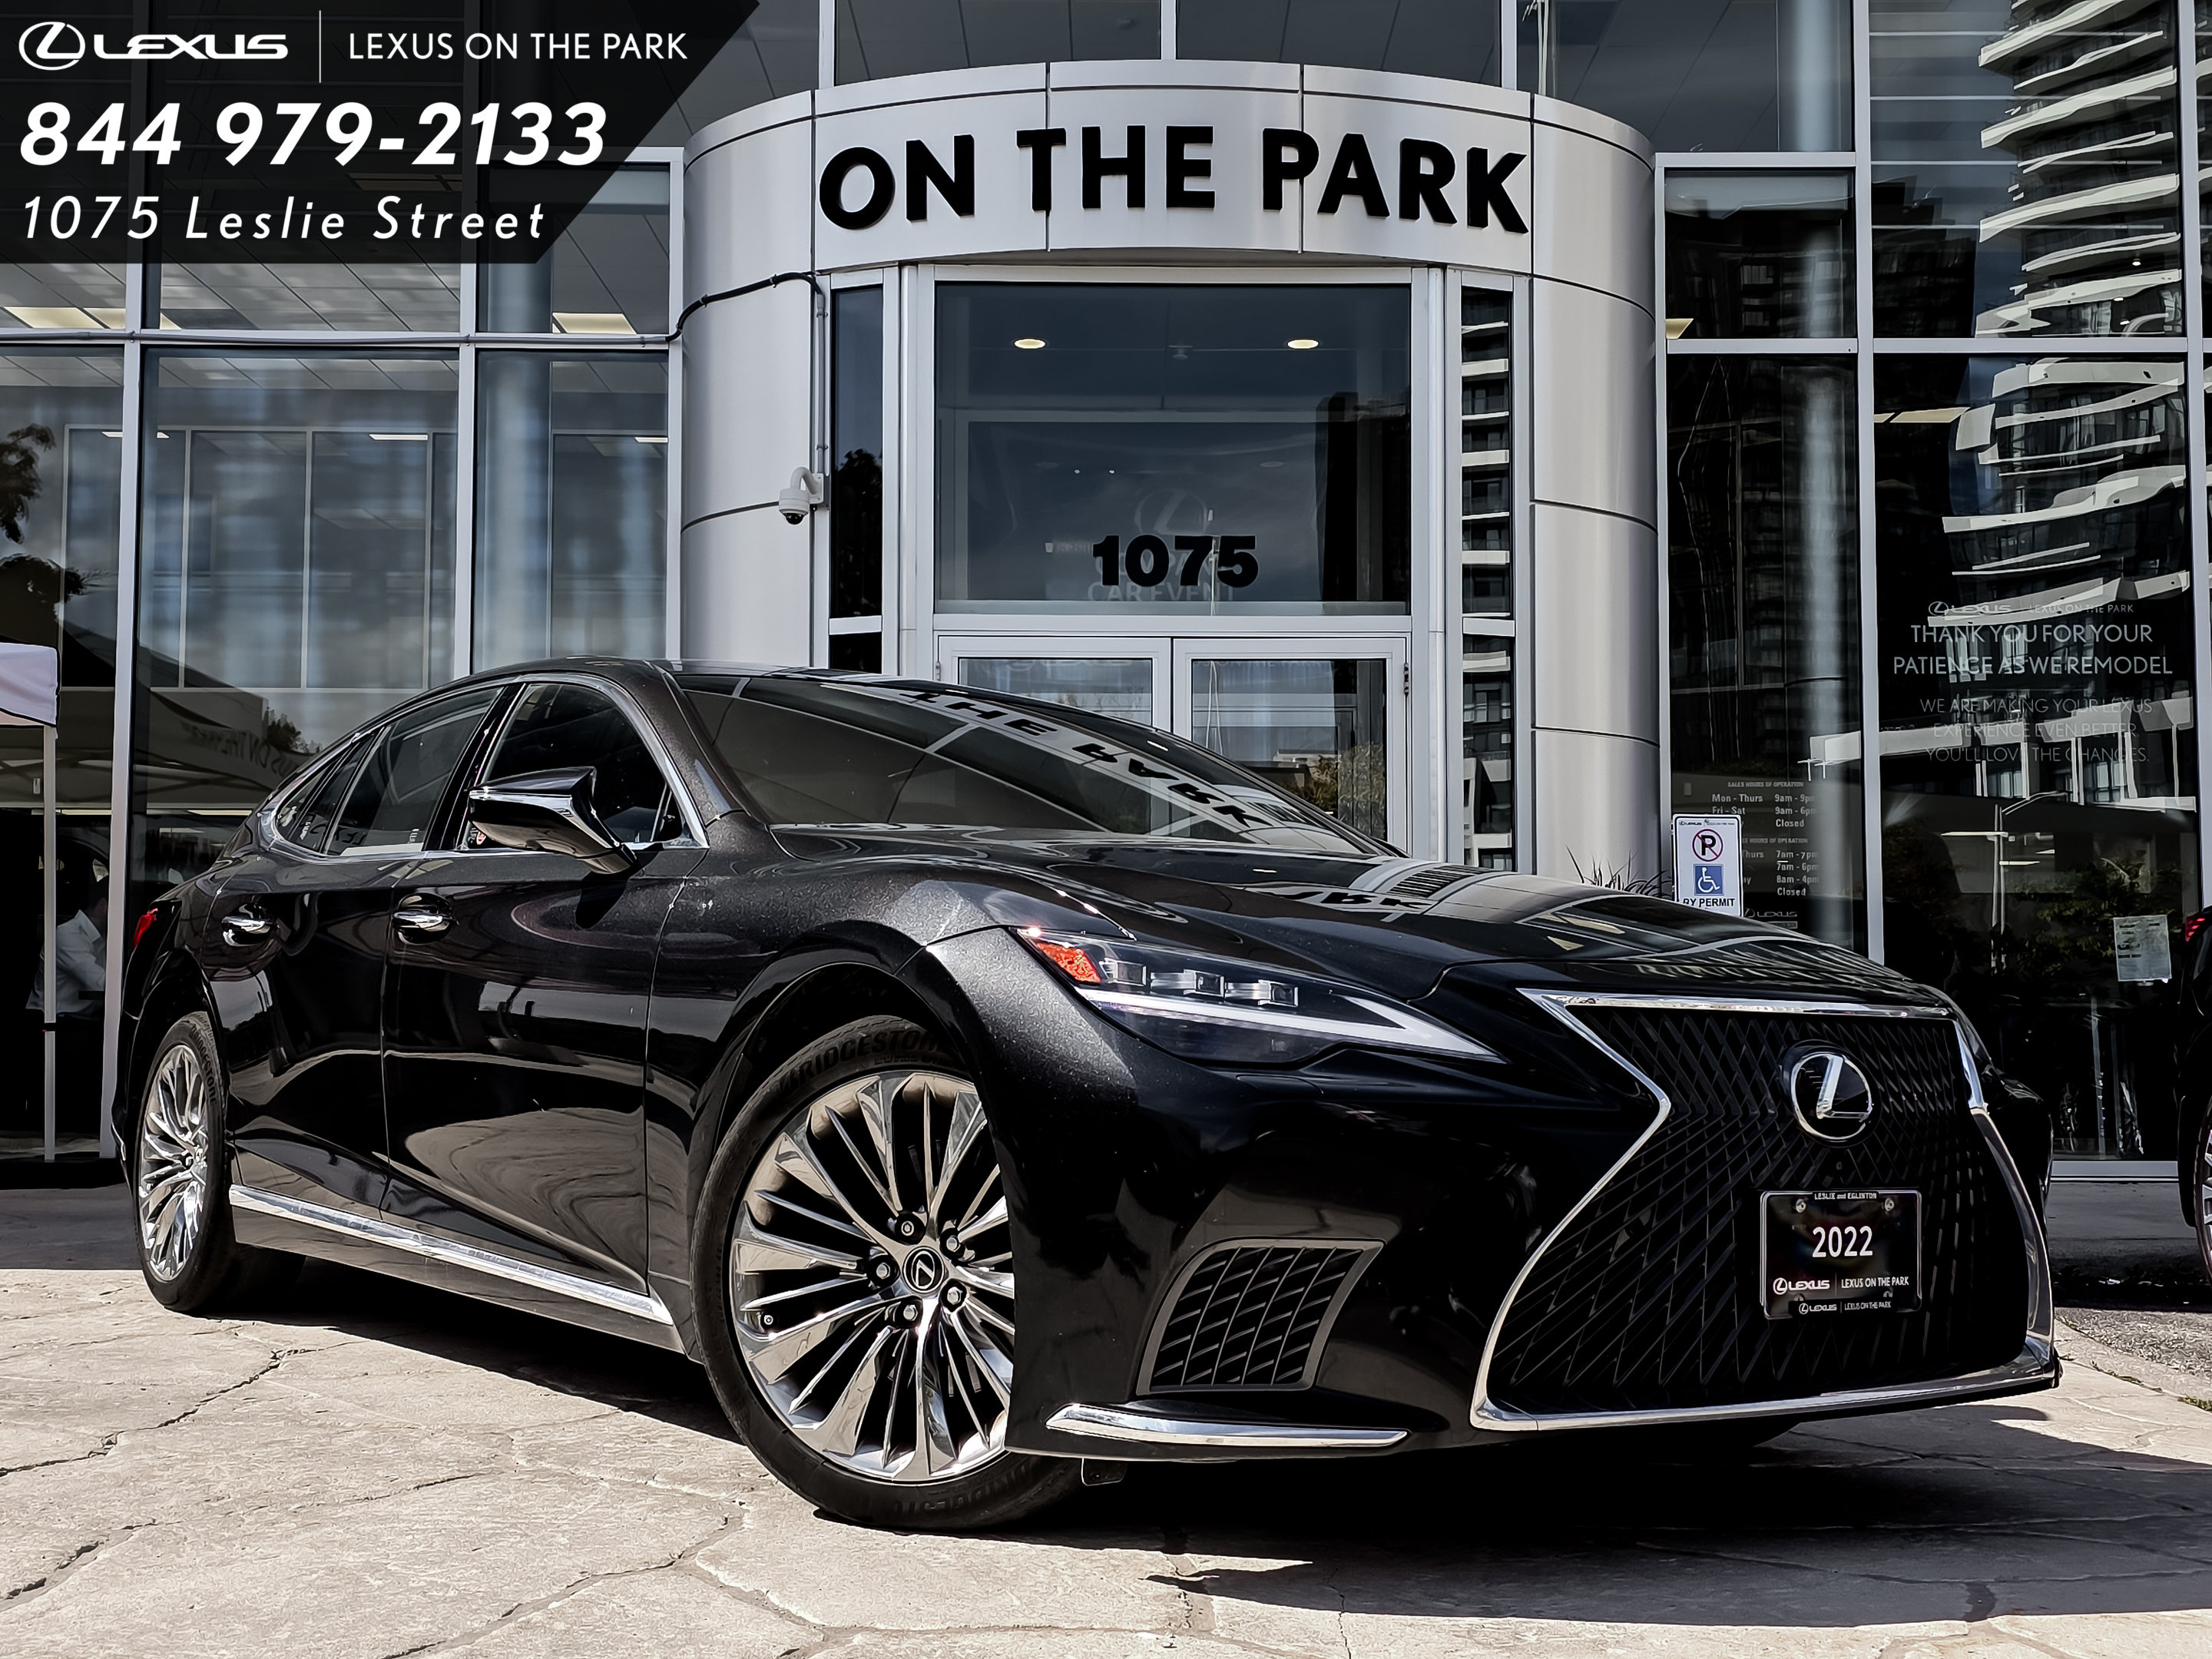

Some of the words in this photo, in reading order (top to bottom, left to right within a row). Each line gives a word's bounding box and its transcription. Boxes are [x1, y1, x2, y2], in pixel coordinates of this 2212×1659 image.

[819, 134, 975, 230] ON
[1016, 124, 1217, 213] THE
[1261, 127, 1529, 234] PARK
[1093, 534, 1259, 588] 1075
[2030, 604, 2062, 613] LEXUS
[2065, 604, 2082, 614] ON
[2108, 604, 2134, 613] PARK
[1910, 624, 1985, 643] THANK
[1989, 624, 2037, 643] YOU
[2042, 624, 2088, 643] FOR
[2088, 624, 2154, 643] YOUR
[1893, 656, 1994, 674] PATIENCE
[1998, 656, 2025, 674] AS
[2028, 656, 2063, 674] WE
[2067, 656, 2173, 674] REMODEL
[1919, 698, 1945, 713] WE
[1949, 698, 1979, 713] ARE
[1983, 698, 2049, 713] MAKING
[2052, 698, 2099, 713] YOUR
[2102, 698, 2153, 713] LEXUS
[1933, 723, 2031, 737] EXPERIENCE
[2036, 723, 2077, 737] EVEN
[1926, 747, 1982, 762] YOU'LL
[2032, 747, 2061, 762] THE
[1712, 793, 1731, 803] Mon
[1738, 793, 1763, 803] Thurs
[1774, 793, 1793, 803] 9am
[1712, 806, 1724, 815] Fri
[1731, 806, 1746, 815] Sat
[1774, 806, 1793, 815] 9am
[1775, 819, 1805, 827] Closed
[1776, 849, 1794, 858] 7am
[1800, 851, 1820, 860] 7pm
[1776, 863, 1794, 871] 7am
[1776, 875, 1795, 883] 8am
[1802, 875, 1820, 885] 4pm
[1777, 887, 1806, 896] Closed
[1698, 898, 1736, 907] PERMIT
[1812, 1226, 1873, 1257] 2022
[1788, 1280, 1830, 1290] LEXUS
[1841, 1277, 1863, 1288] LEXUS
[1865, 1277, 1876, 1287] ON
[1878, 1277, 1890, 1286] THE
[1892, 1277, 1909, 1286] PARK
